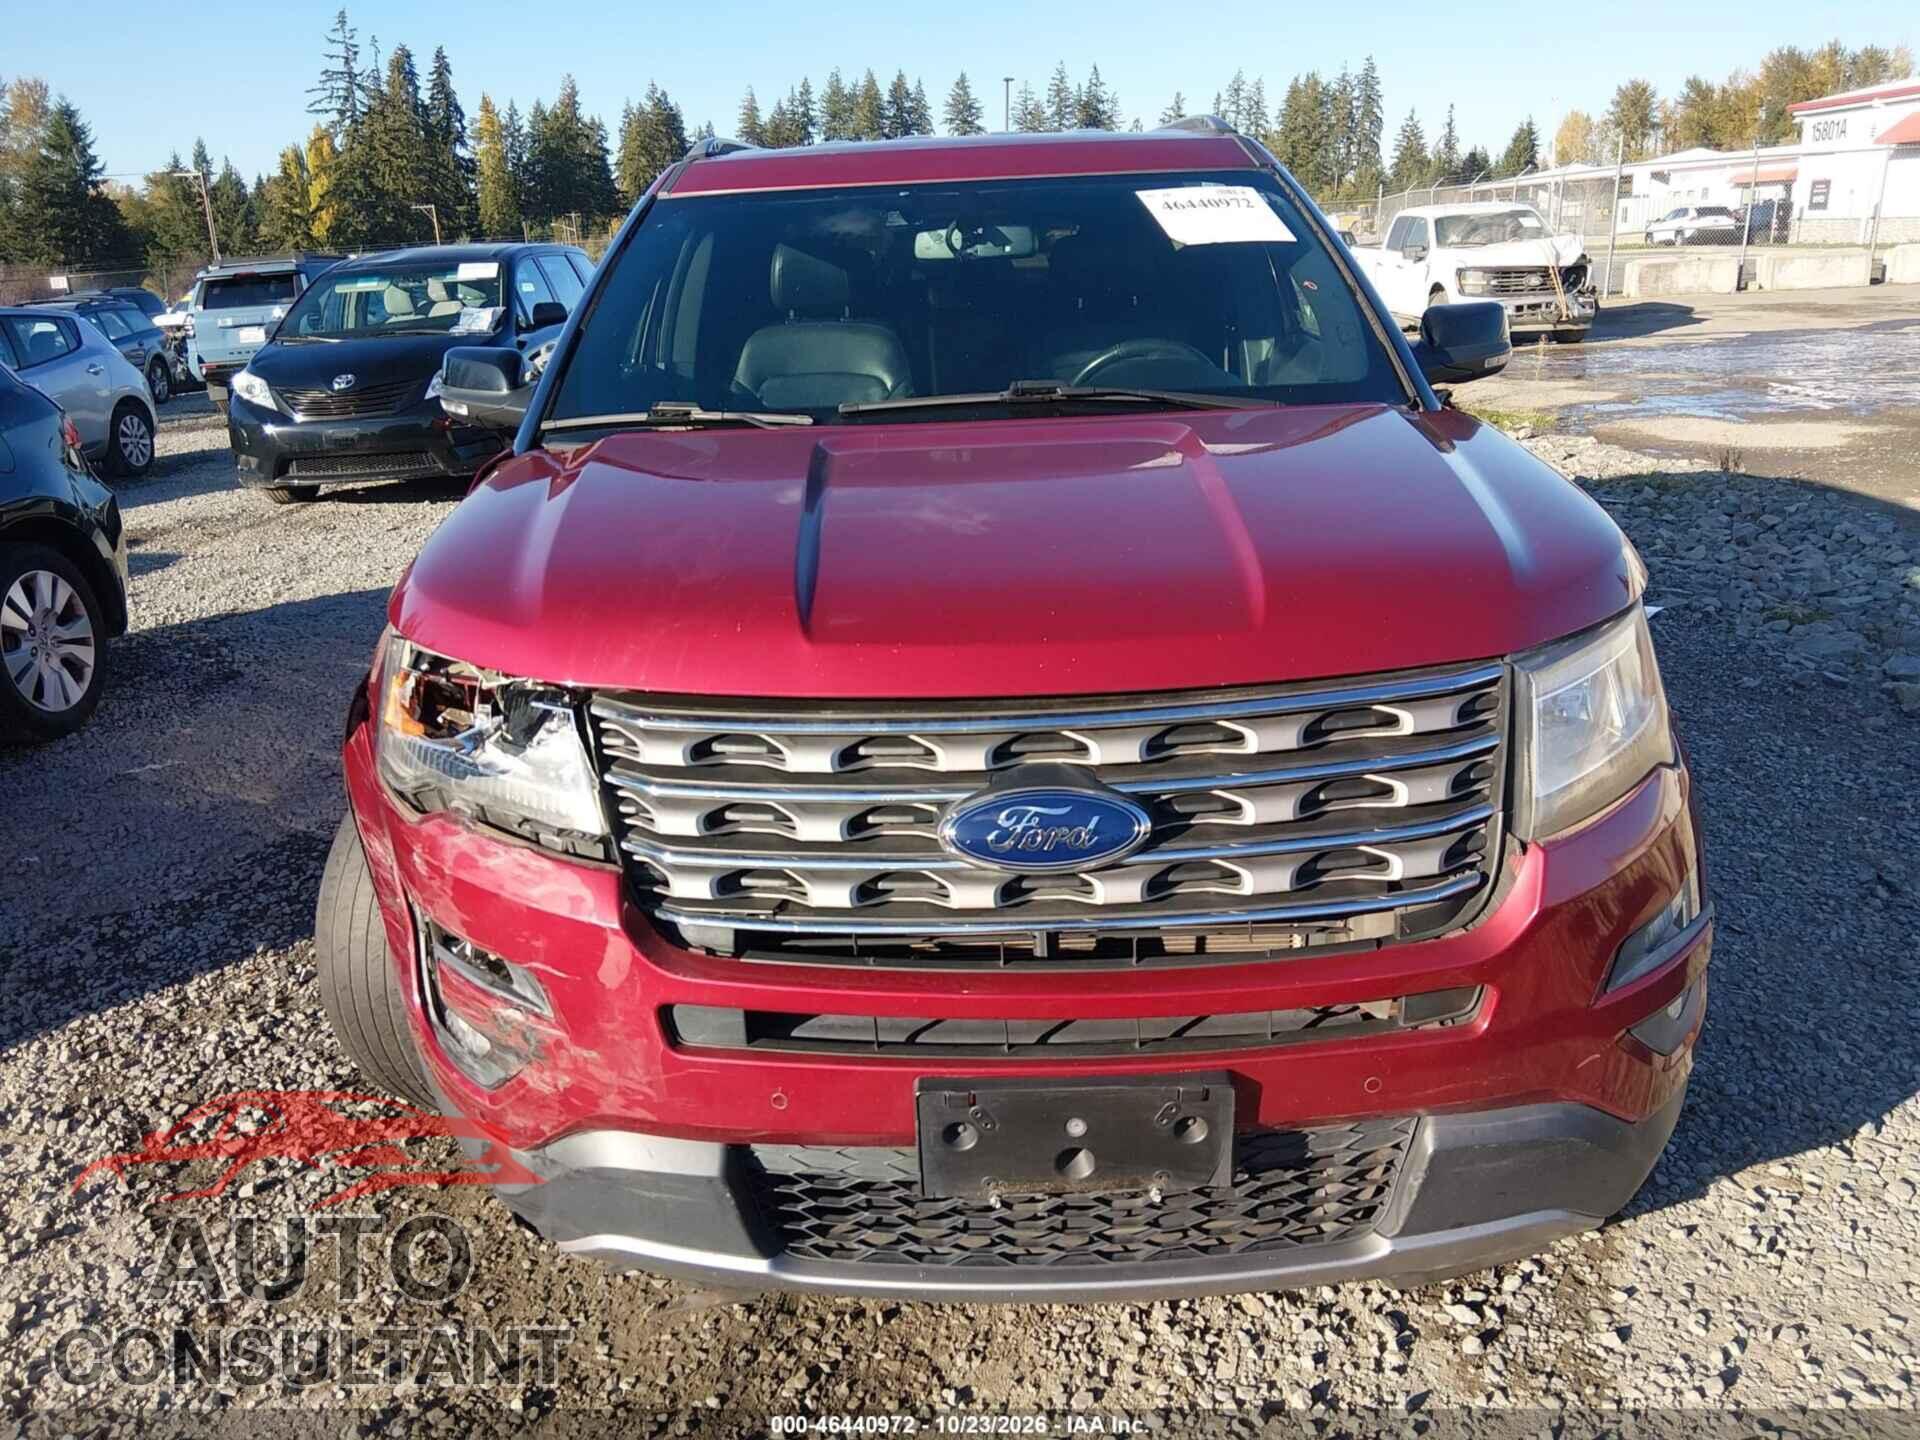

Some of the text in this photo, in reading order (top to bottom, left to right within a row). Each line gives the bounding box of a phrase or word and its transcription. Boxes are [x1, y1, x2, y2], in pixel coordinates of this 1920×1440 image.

[1811, 118, 1848, 142] 15801A
[1161, 197, 1255, 211] 46440972
[986, 804, 1101, 853] Ford
